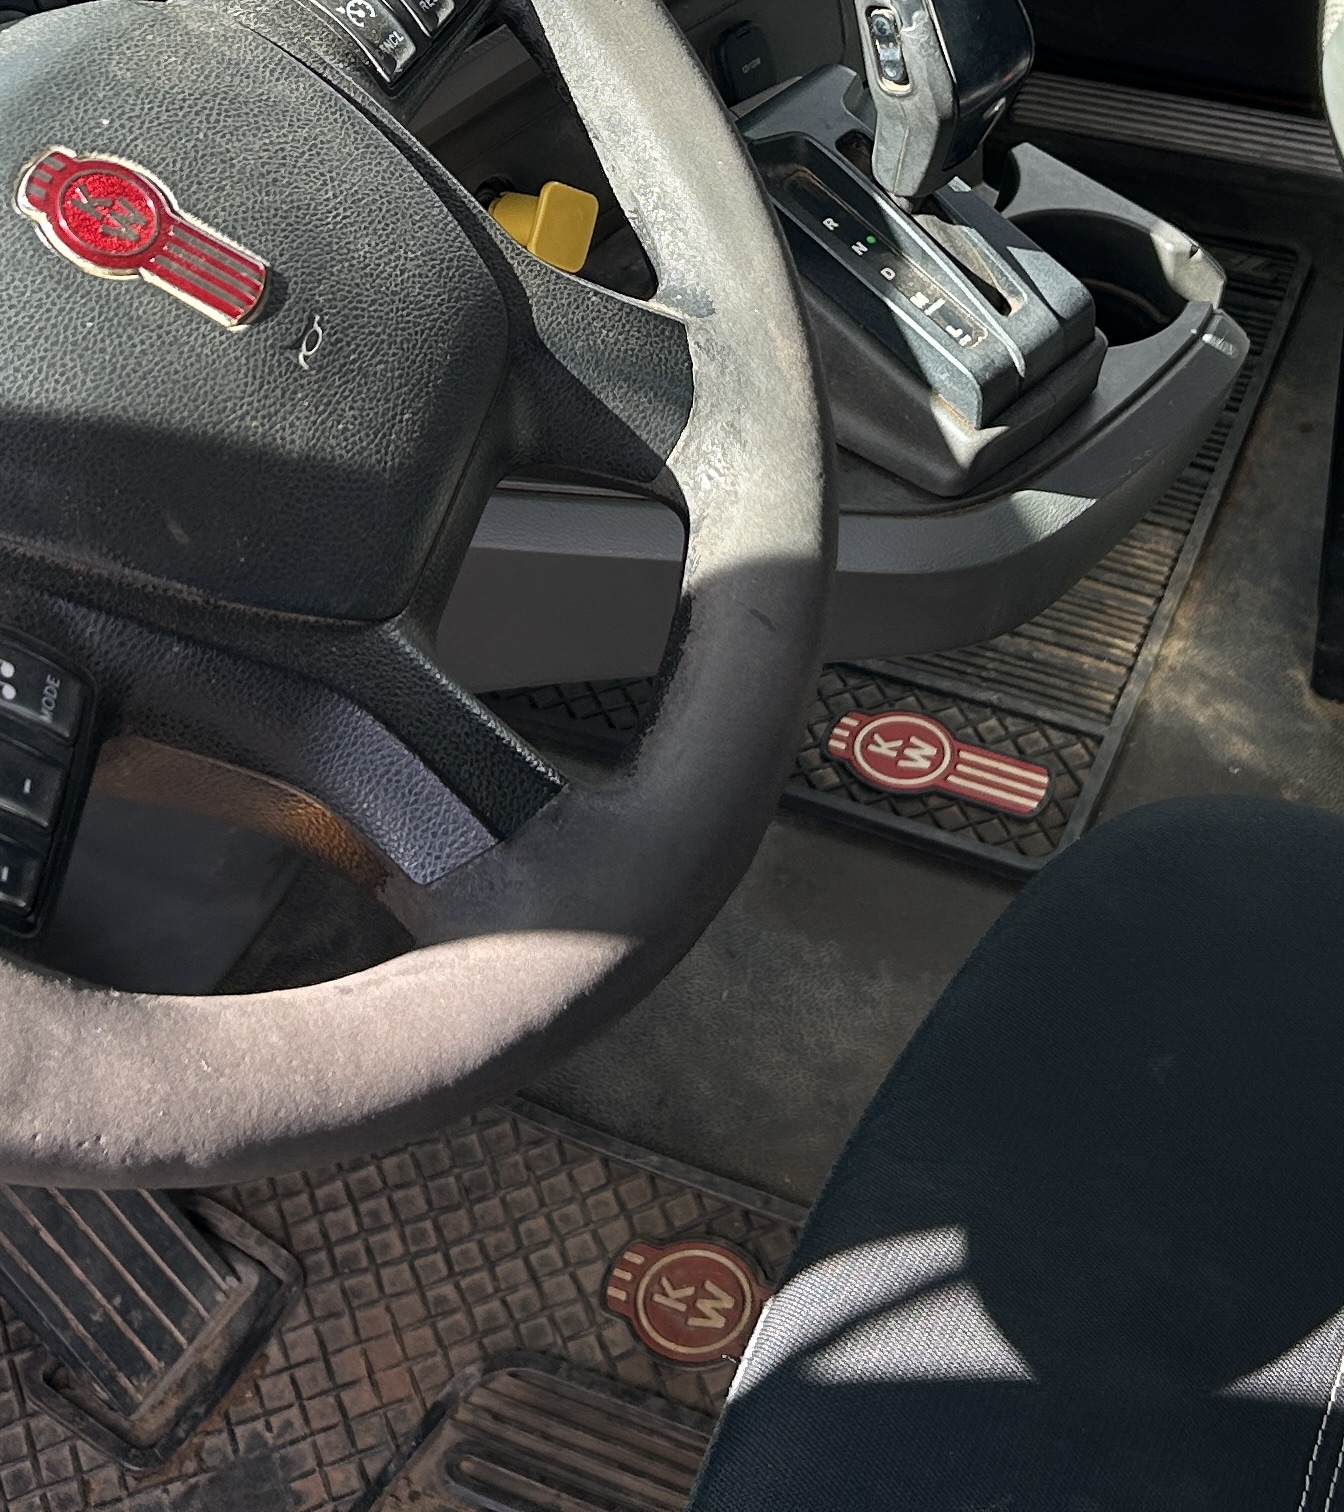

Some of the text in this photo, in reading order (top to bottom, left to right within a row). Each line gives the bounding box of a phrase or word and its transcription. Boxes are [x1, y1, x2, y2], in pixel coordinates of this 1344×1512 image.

[822, 217, 840, 231] R
[851, 241, 869, 256] N
[880, 266, 896, 281] D
[39, 673, 62, 724] MODE
